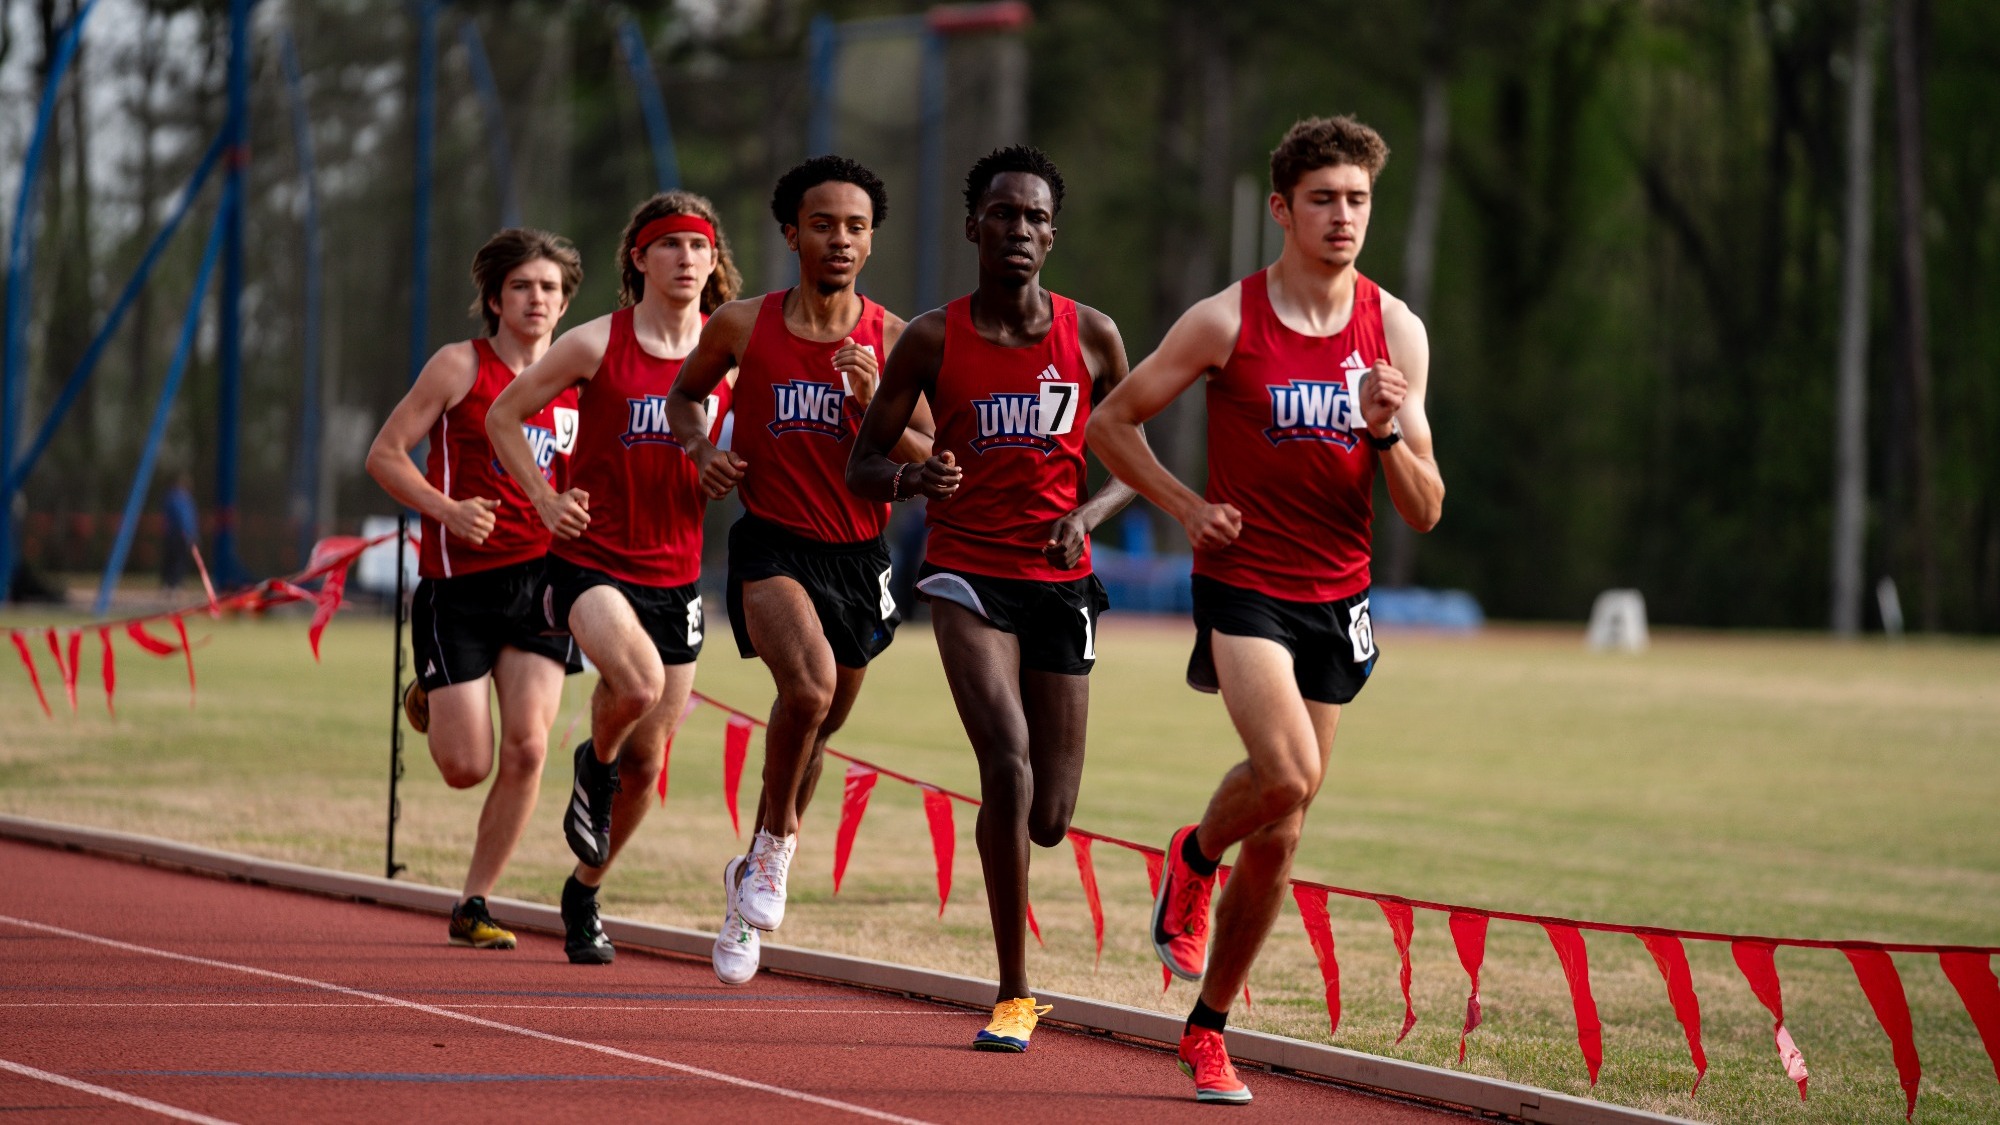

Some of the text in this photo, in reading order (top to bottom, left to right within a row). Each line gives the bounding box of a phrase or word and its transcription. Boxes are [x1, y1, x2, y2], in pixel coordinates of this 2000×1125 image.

[632, 398, 671, 433] UW
[778, 384, 840, 426] UWG
[1049, 385, 1072, 431] 7
[1275, 384, 1352, 433] UWG
[522, 426, 557, 468] WG
[561, 413, 575, 449] 9
[980, 437, 1047, 447] WOLVES
